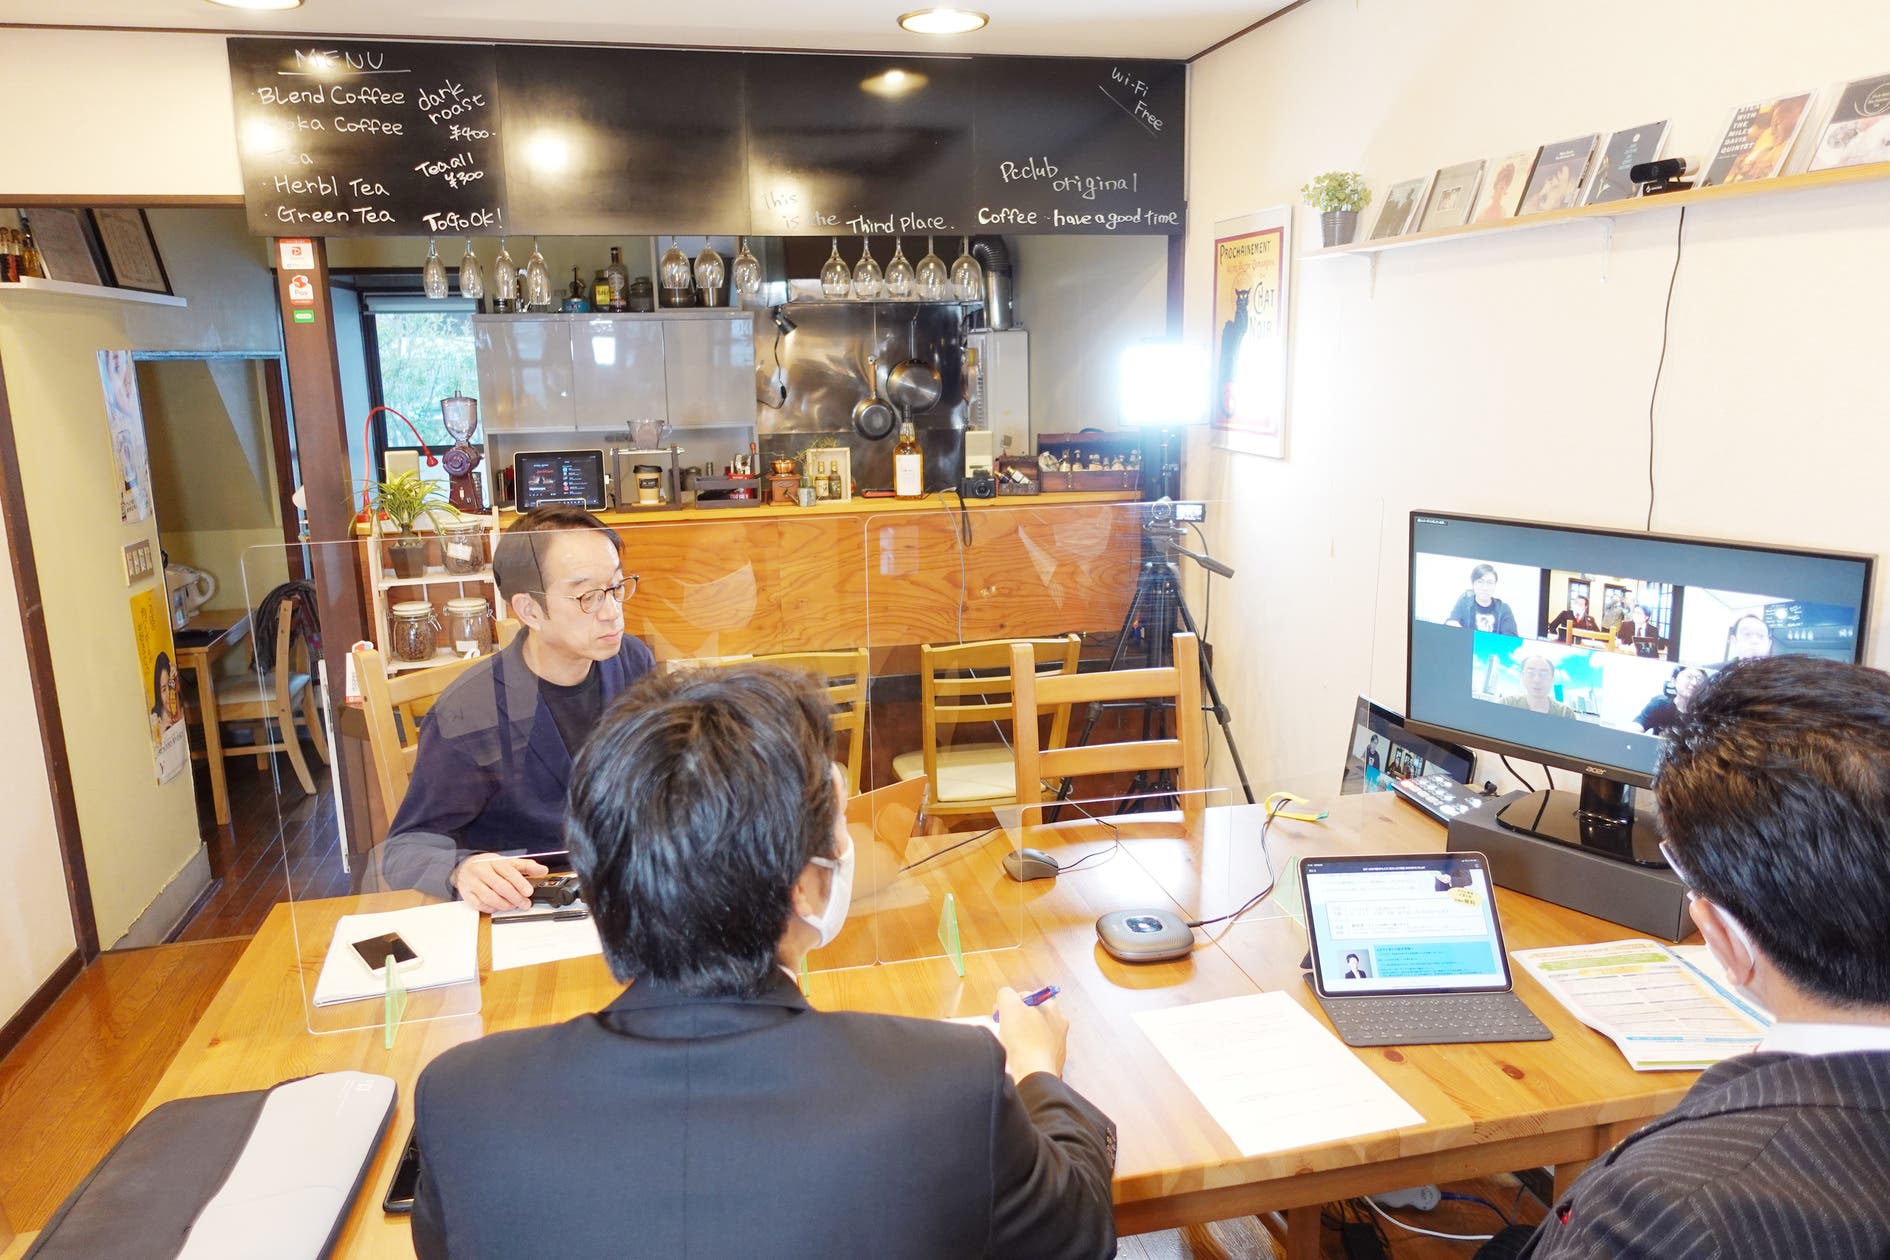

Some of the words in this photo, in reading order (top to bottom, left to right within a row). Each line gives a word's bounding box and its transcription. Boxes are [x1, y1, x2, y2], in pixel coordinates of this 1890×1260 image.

[295, 48, 384, 70] MENU
[1111, 67, 1149, 97] Wi-Fi
[330, 86, 405, 105] Coffee
[418, 79, 465, 111] dark
[428, 94, 486, 125] roast
[1134, 100, 1163, 131] Free
[334, 116, 404, 135] Coffee
[349, 178, 391, 197] Tea
[1052, 172, 1137, 200] original
[760, 190, 799, 210] This
[277, 205, 350, 224] Green
[353, 206, 396, 224] Tea
[846, 213, 894, 234] Third
[978, 207, 1038, 225] Coffee
[1053, 208, 1092, 227] have
[1094, 213, 1105, 223] a
[1105, 207, 1142, 230] good
[1143, 209, 1180, 226] time
[1220, 240, 1272, 265] PROCHAINEMENT
